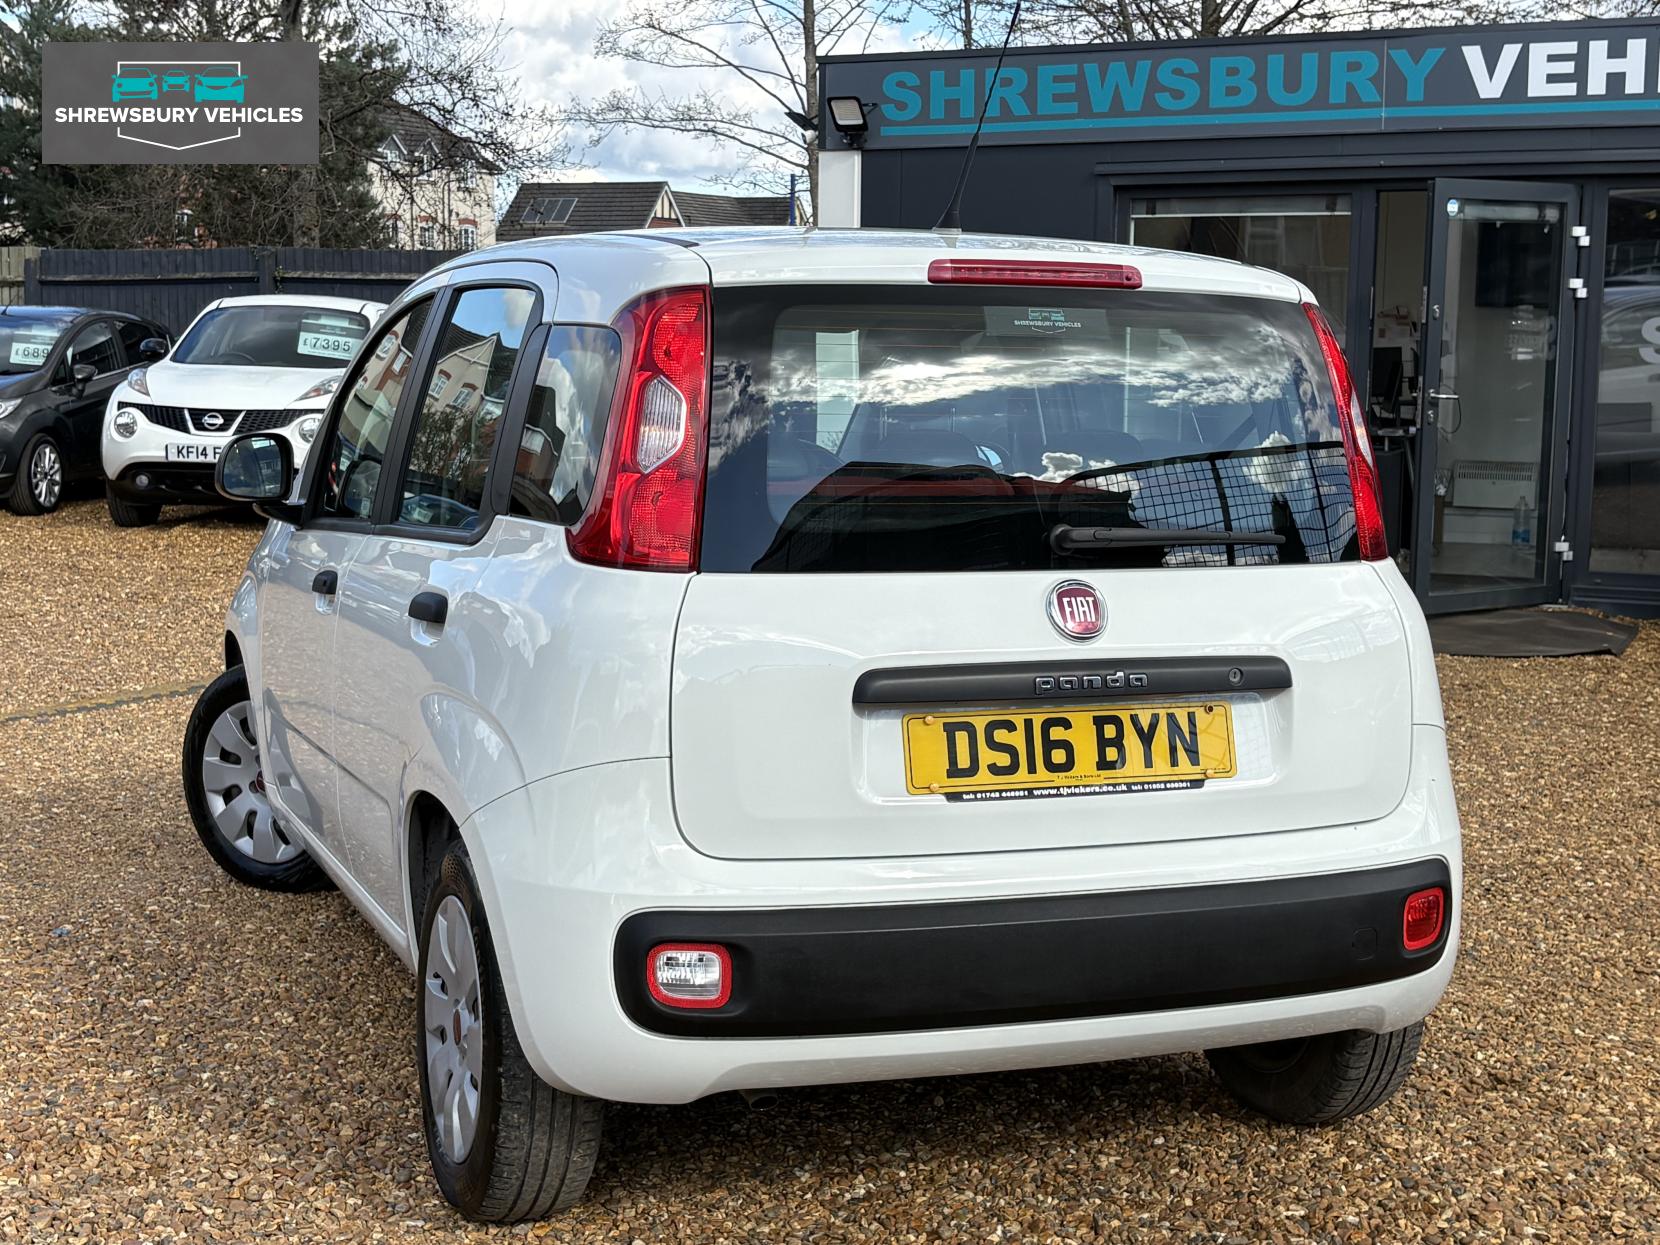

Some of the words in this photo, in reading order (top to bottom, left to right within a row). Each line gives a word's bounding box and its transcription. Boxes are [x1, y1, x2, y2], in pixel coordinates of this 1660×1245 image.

[881, 48, 1446, 121] SHREWSBURY
[1462, 38, 1660, 98] VEH
[1014, 319, 1053, 327] SHREWSBURY
[15, 346, 50, 358] £689
[303, 337, 351, 352] £7395
[176, 445, 209, 460] KF14
[212, 446, 223, 460] F
[1062, 596, 1096, 623] FIAT
[1035, 671, 1148, 696] panda
[944, 715, 1075, 780] DS16
[1093, 711, 1201, 772] BYN
